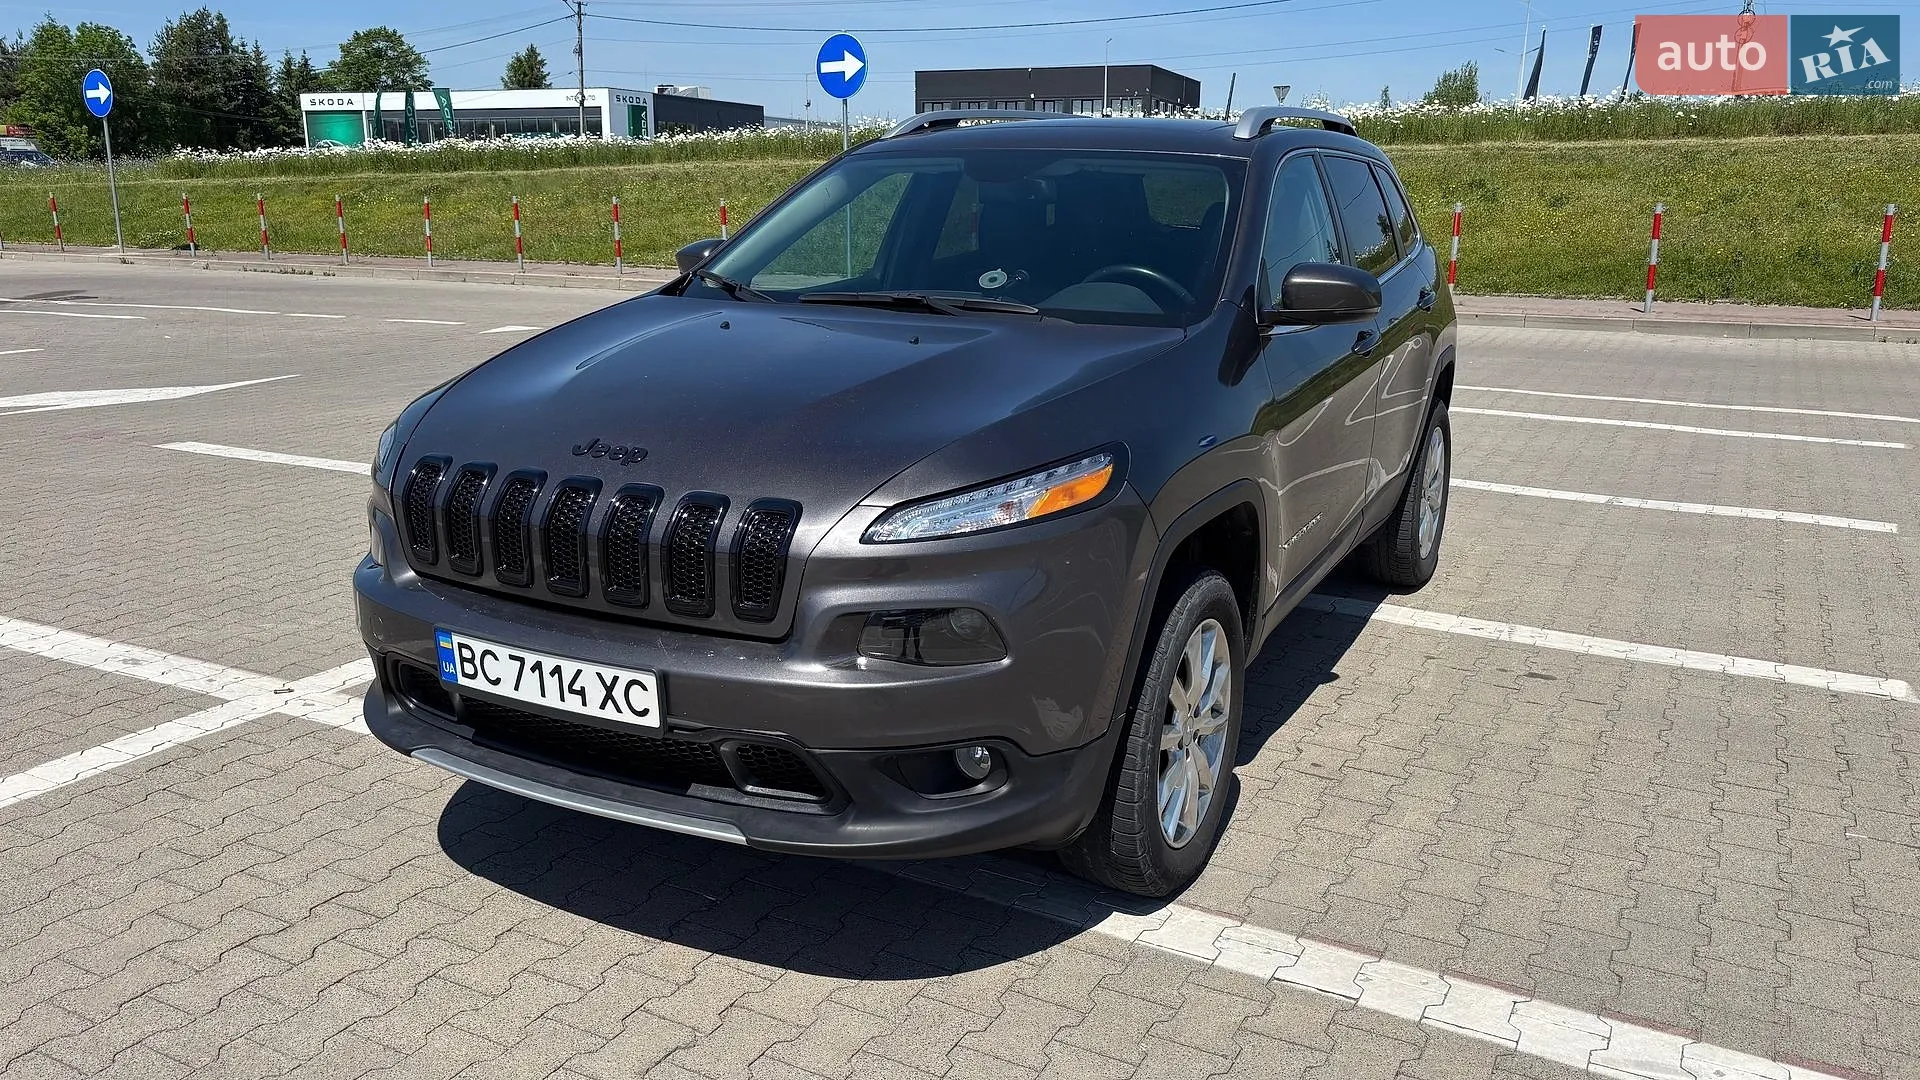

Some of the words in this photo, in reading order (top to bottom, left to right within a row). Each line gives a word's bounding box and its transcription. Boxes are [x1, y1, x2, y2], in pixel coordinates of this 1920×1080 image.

[572, 438, 648, 466] Jeep
[442, 662, 456, 674] UA
[457, 642, 502, 686] BC
[508, 654, 587, 707] 7114
[595, 671, 650, 718] XC
